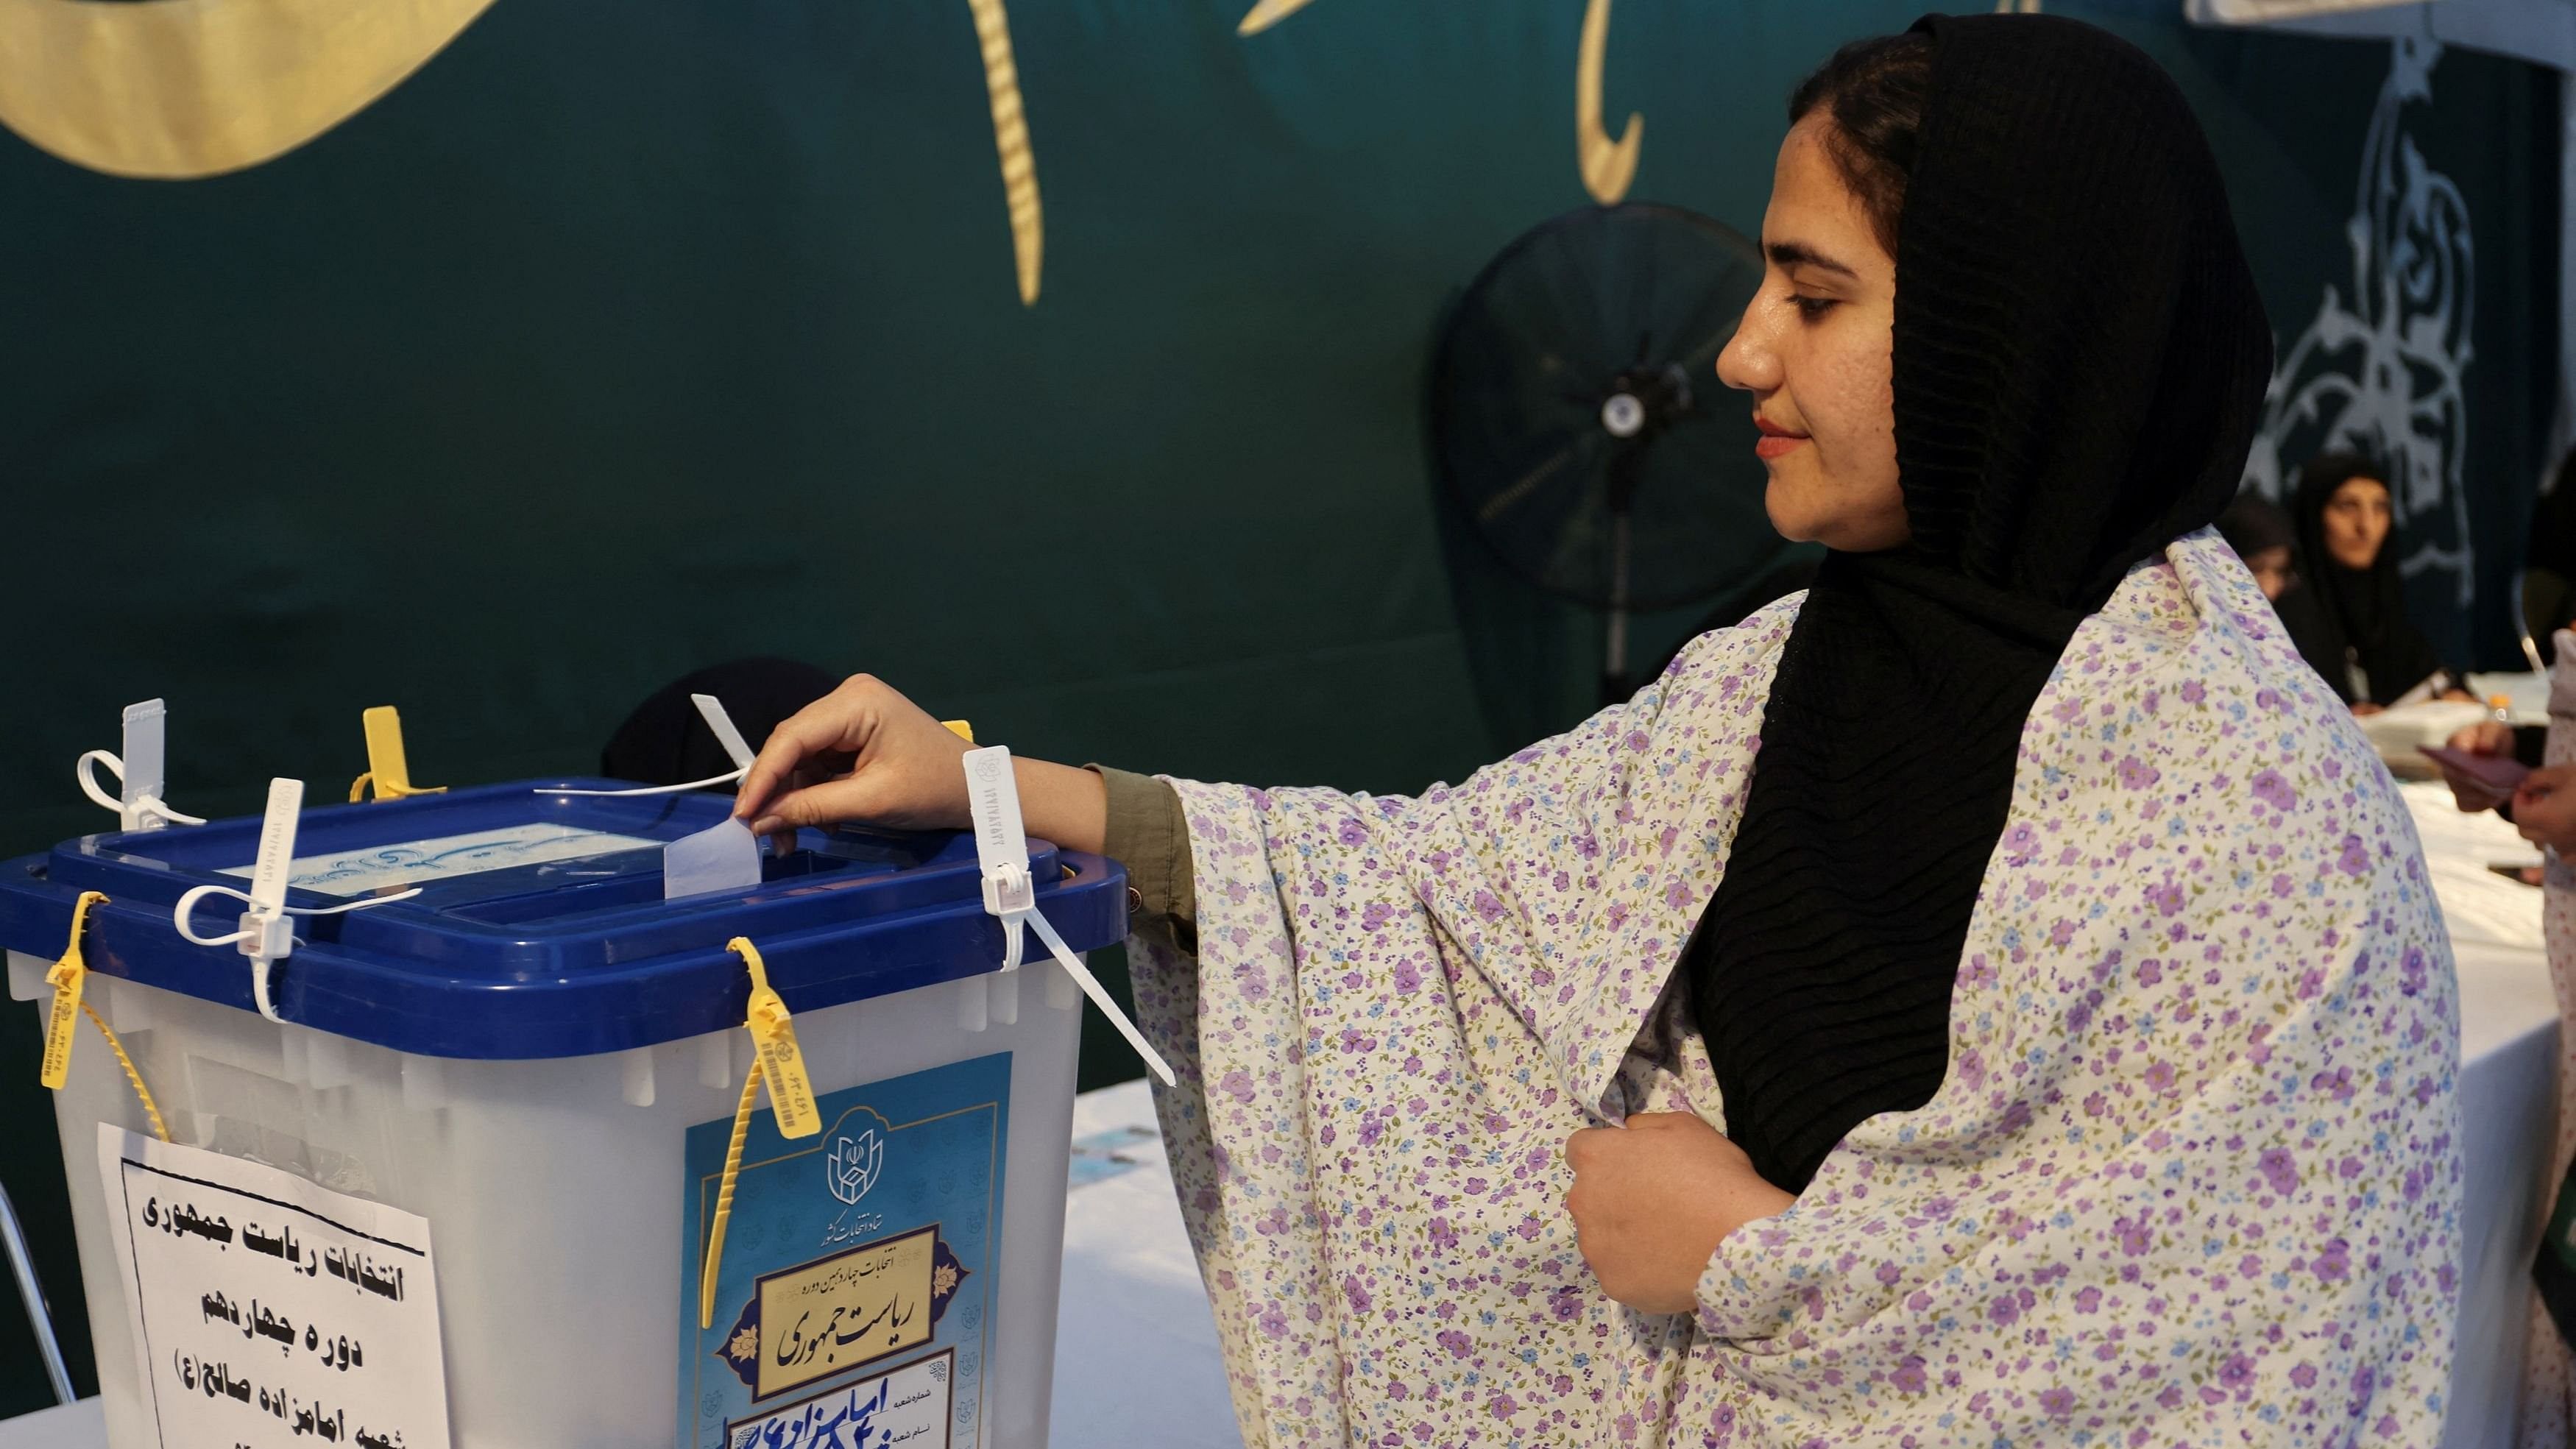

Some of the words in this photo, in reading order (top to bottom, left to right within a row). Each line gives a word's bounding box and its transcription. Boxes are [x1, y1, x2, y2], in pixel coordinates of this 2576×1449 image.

[143, 1196, 233, 1251] جمهوری
[242, 1221, 316, 1276] ریاست
[325, 1247, 404, 1303] انتخابات
[860, 1246, 896, 1279] انتخابات
[776, 1306, 846, 1367] جمهوری
[835, 1292, 914, 1346] ریاست
[305, 1325, 363, 1371] دوره
